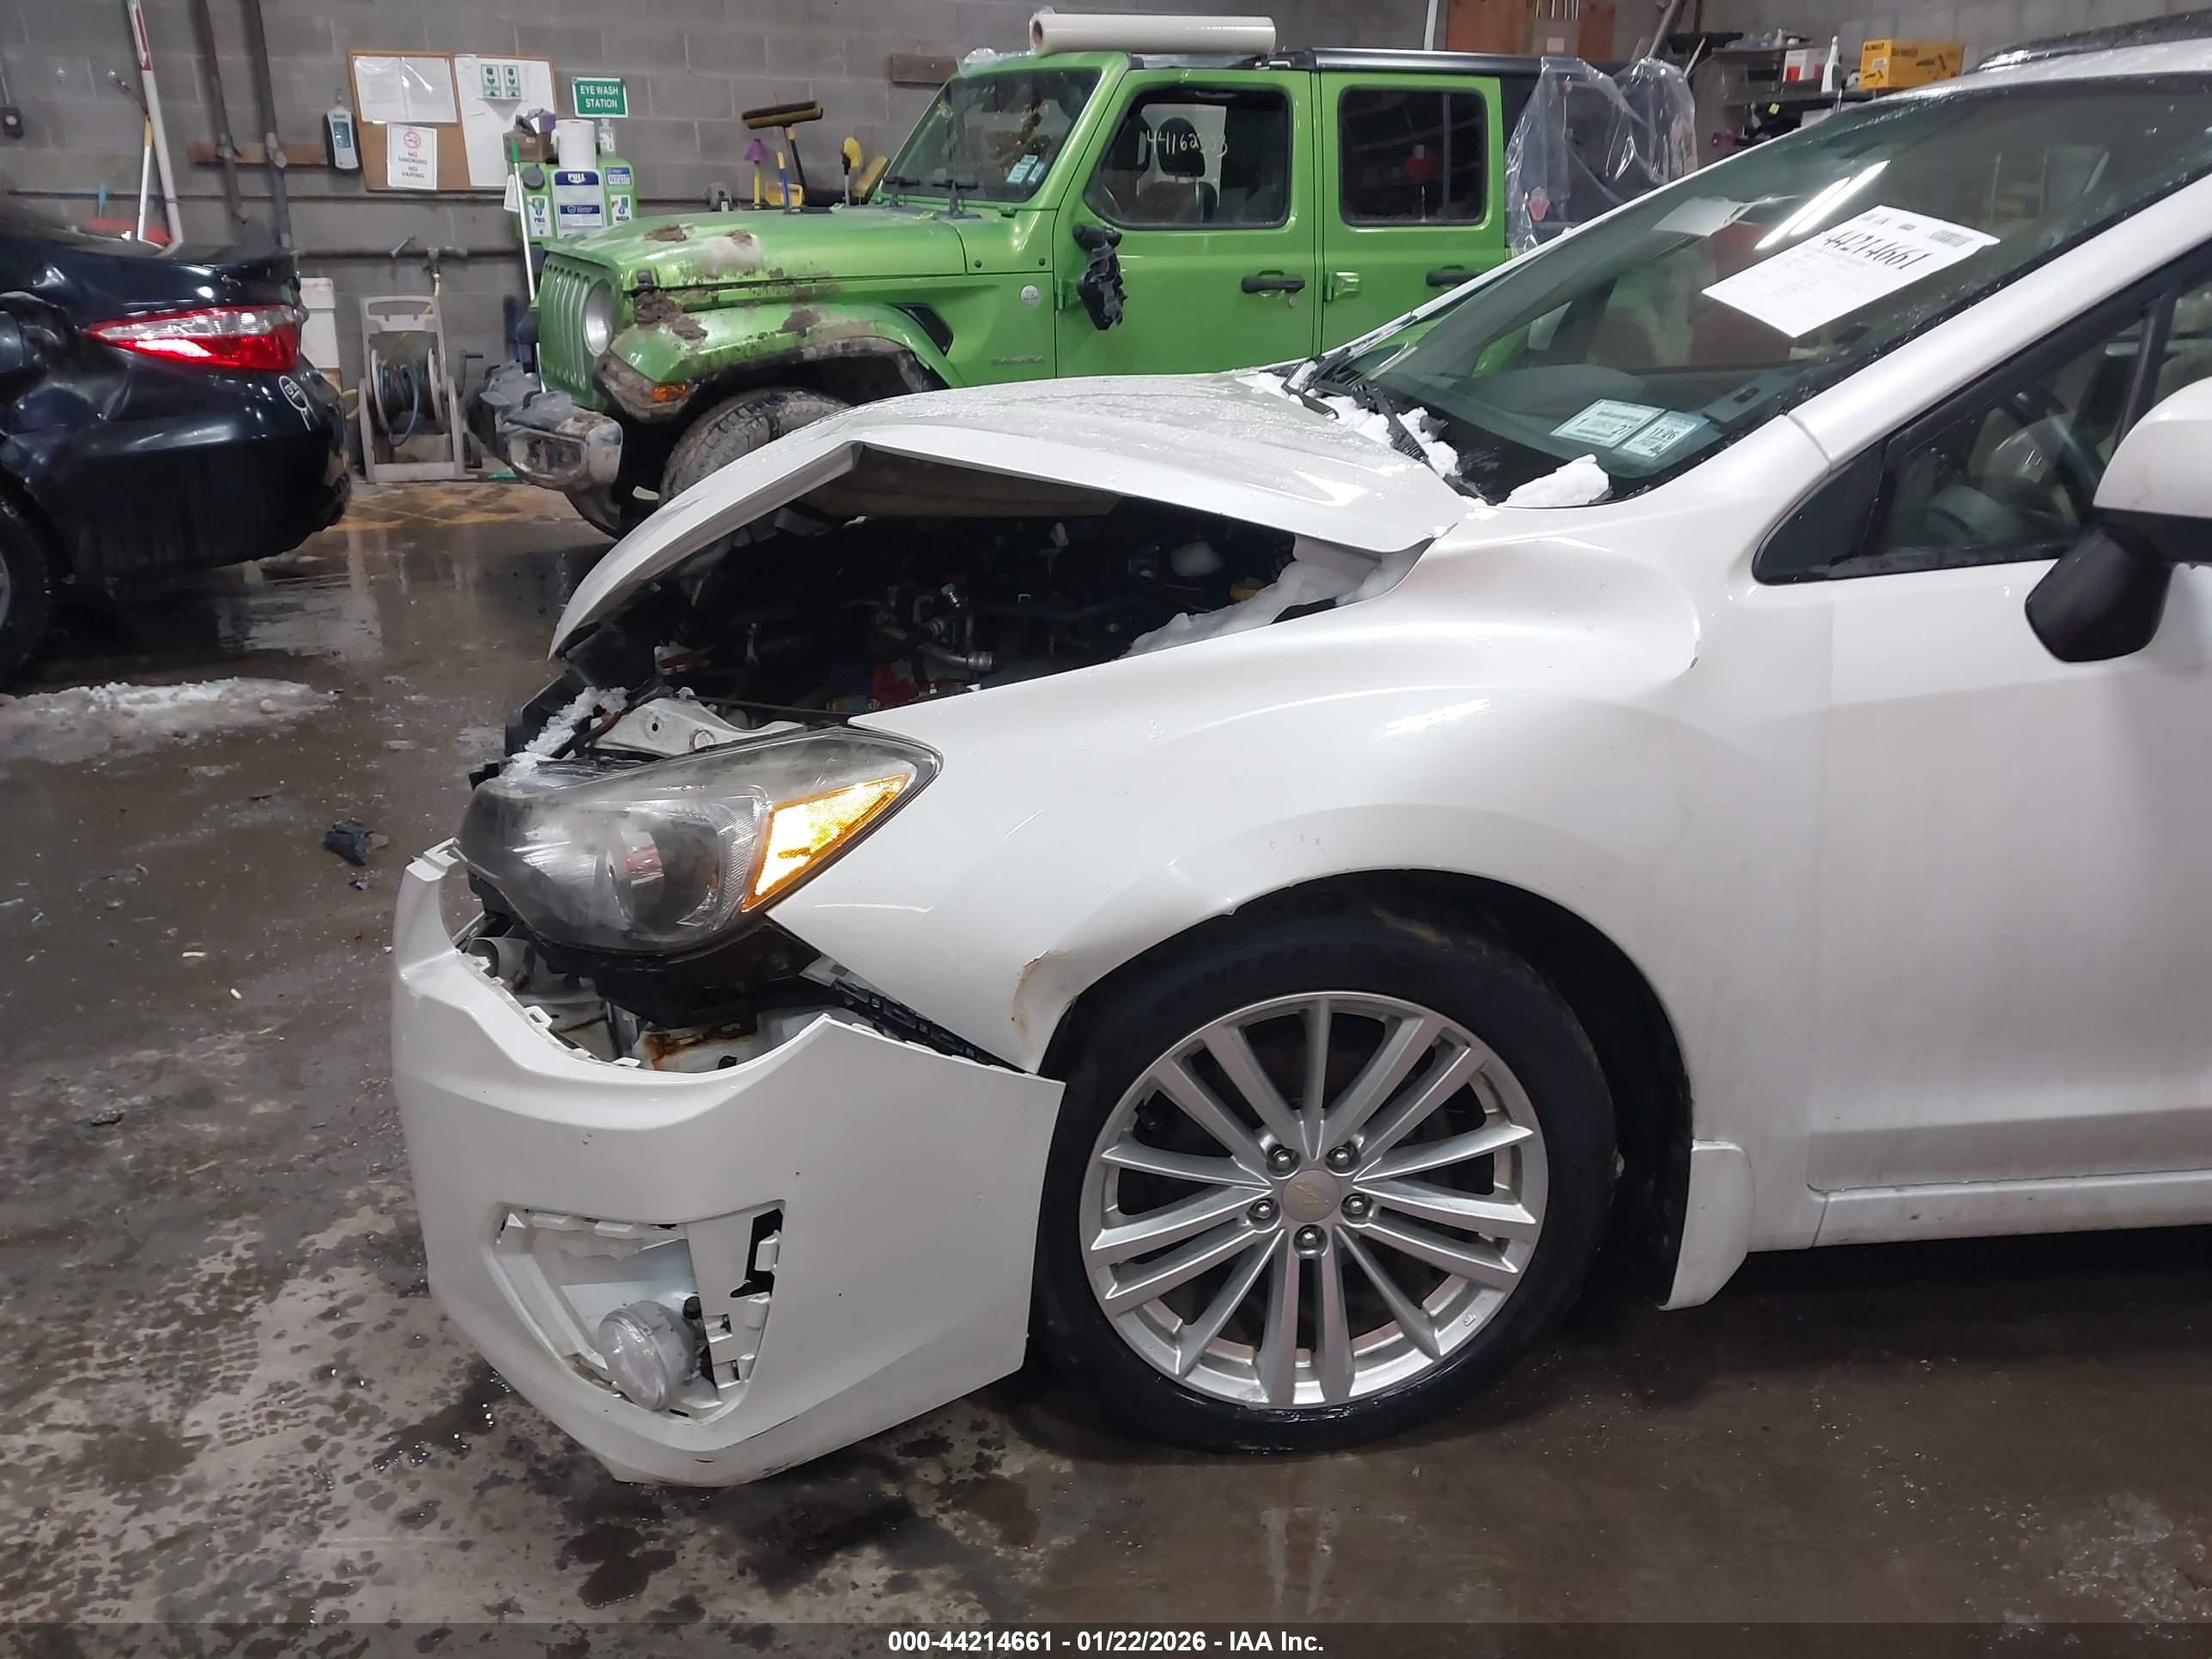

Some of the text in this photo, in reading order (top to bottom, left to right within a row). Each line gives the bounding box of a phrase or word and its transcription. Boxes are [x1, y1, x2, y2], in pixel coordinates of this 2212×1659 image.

[580, 85, 619, 95] EYE WASH
[585, 98, 618, 108] STATION
[398, 156, 428, 165] SMOKING
[1823, 230, 1934, 270] 44214661
